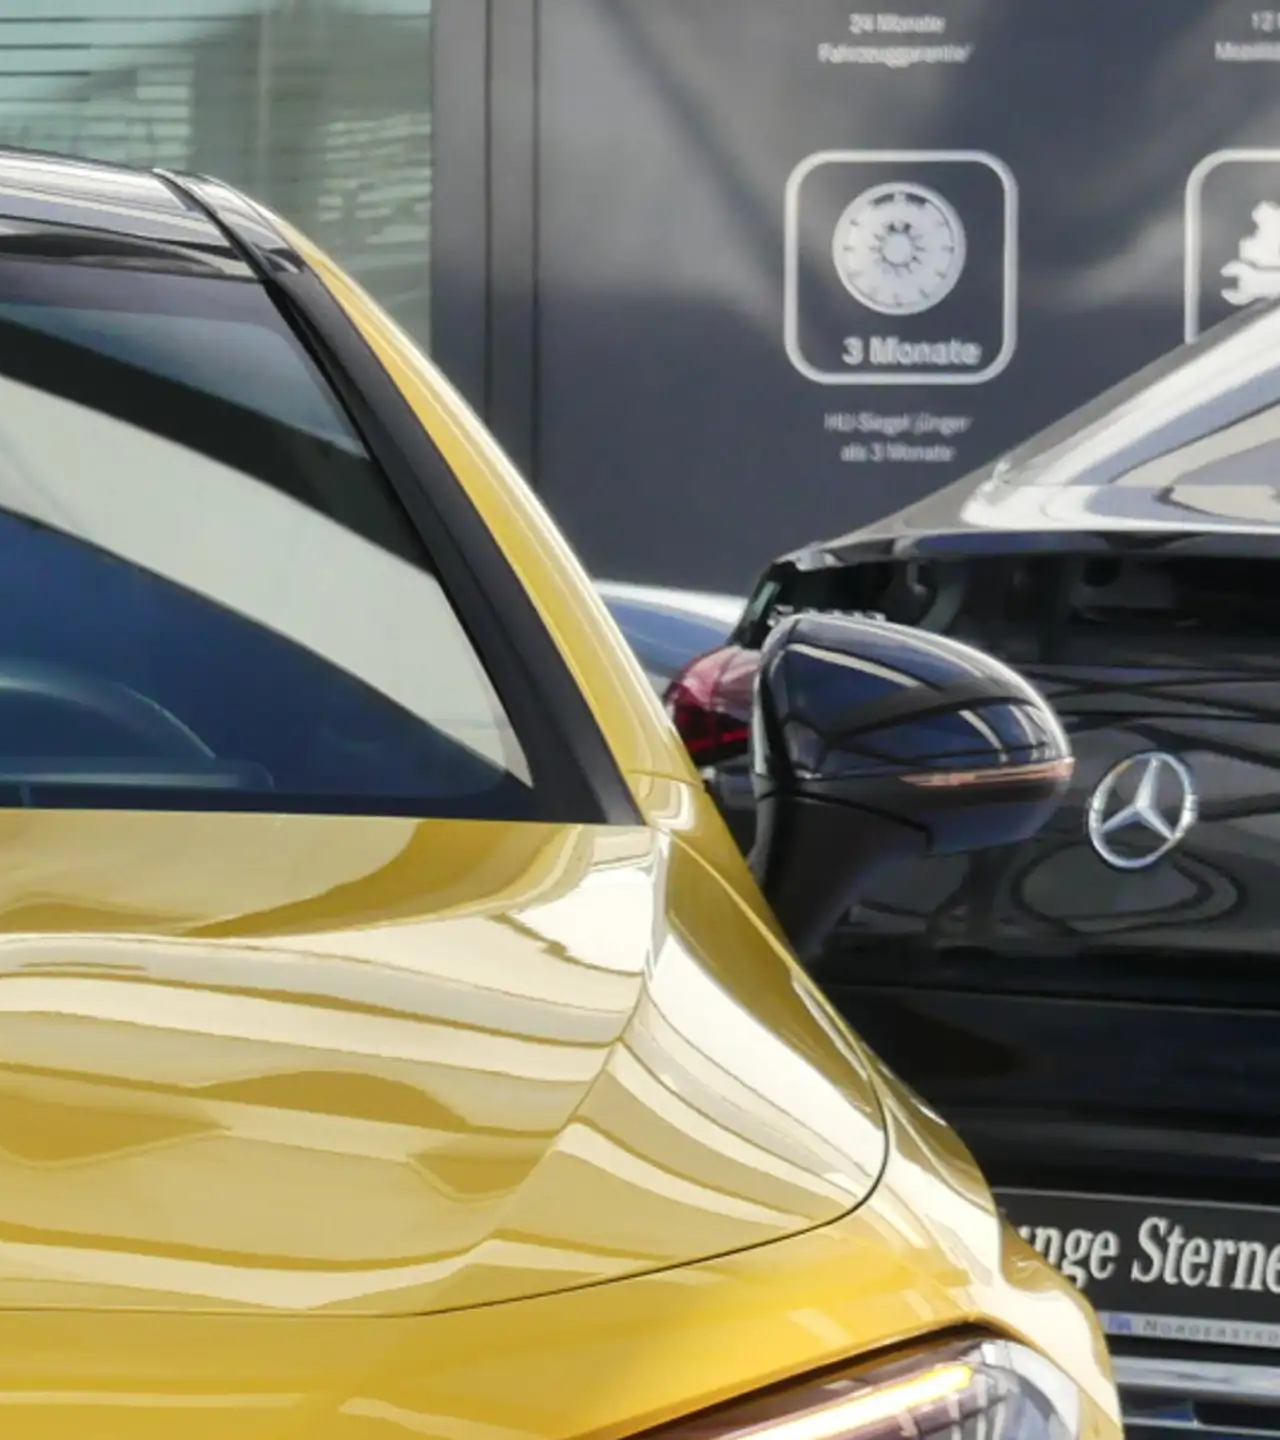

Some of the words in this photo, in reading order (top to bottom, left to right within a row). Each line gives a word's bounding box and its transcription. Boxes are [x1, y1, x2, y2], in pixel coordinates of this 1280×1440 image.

[876, 12, 945, 33] Monate
[842, 336, 864, 365] 3
[869, 336, 983, 365] Monate
[870, 442, 885, 462] 3
[886, 441, 955, 462] Monate
